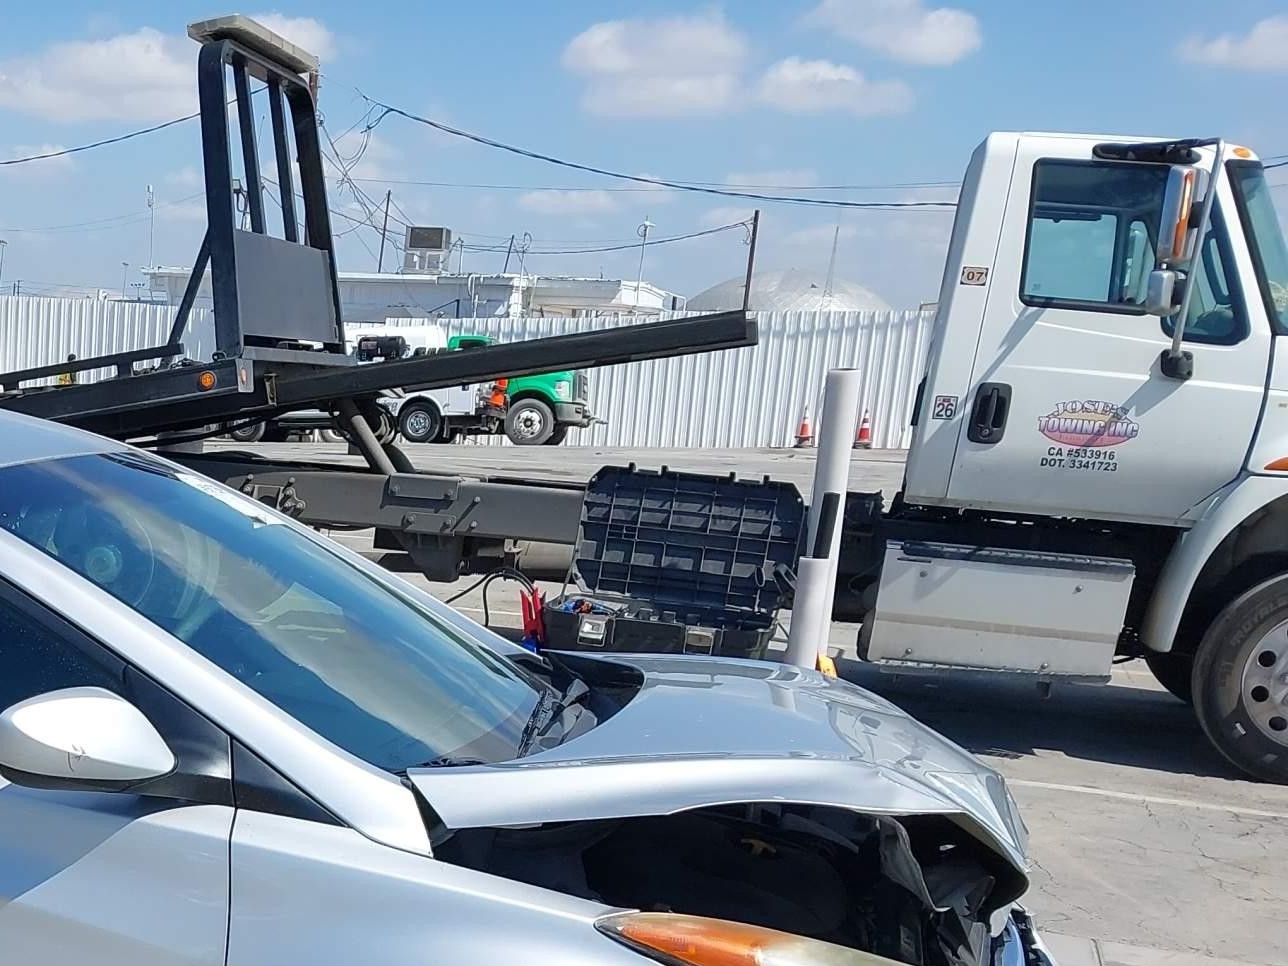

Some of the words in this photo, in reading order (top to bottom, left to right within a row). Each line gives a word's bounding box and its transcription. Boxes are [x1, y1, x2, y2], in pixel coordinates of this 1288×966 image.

[966, 271, 984, 281] 07
[935, 402, 954, 418] 26
[1039, 416, 1106, 436] TOWING
[1107, 420, 1140, 439] INC
[1047, 446, 1063, 457] CA
[1066, 447, 1116, 461] #533916
[1040, 457, 1065, 469] DOT.
[1068, 459, 1118, 472] 3341723
